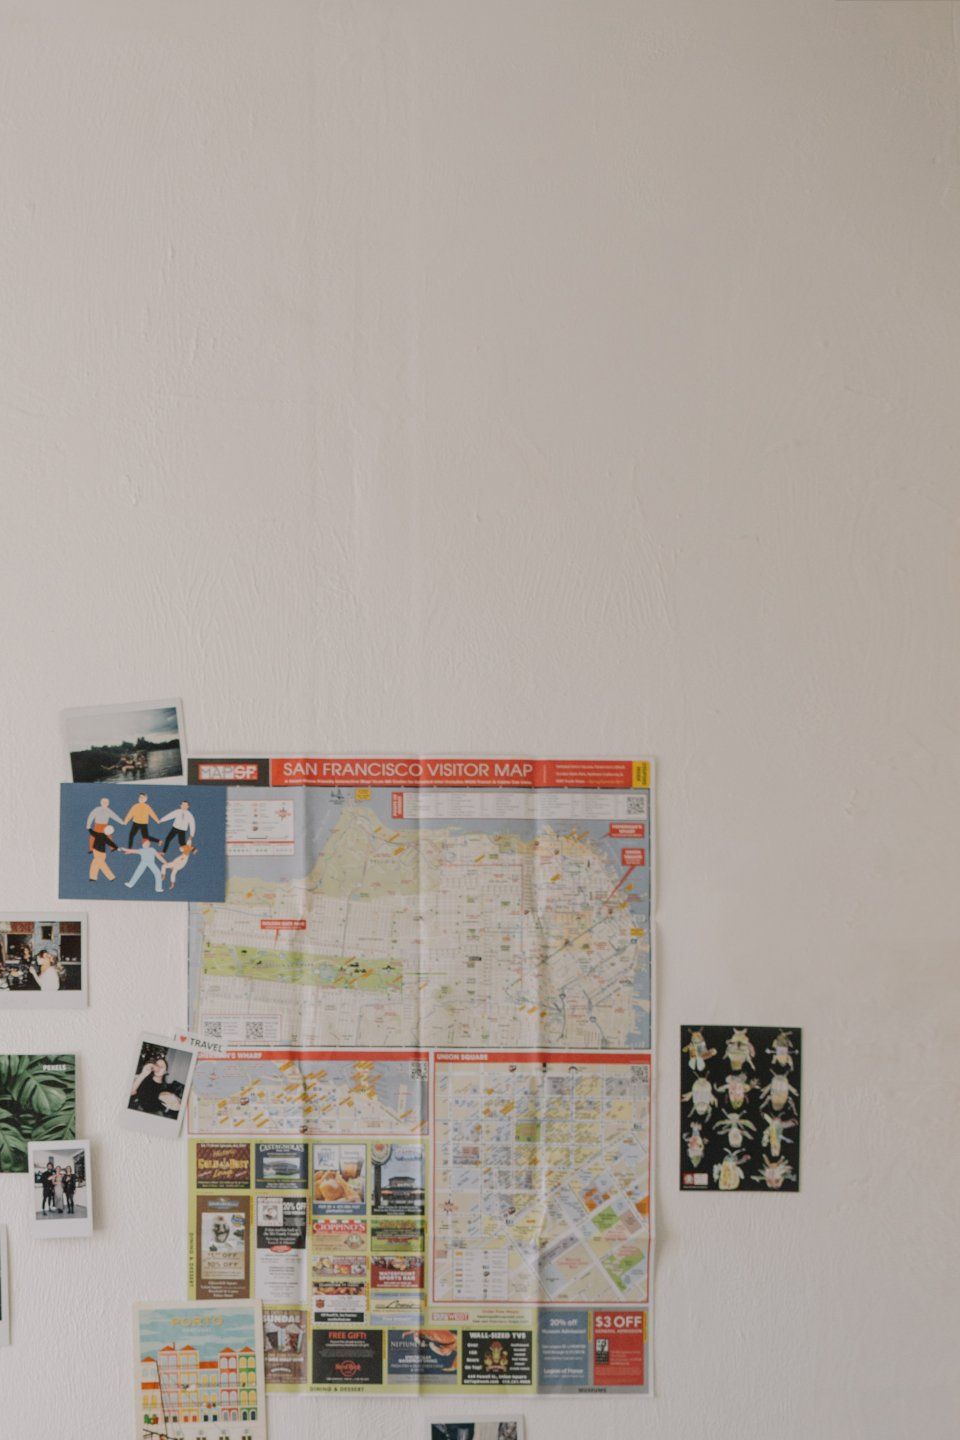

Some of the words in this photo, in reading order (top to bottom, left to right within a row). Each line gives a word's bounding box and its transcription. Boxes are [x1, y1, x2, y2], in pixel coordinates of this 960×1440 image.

[283, 762, 318, 777] SAN
[322, 762, 424, 777] FRANCISCO
[427, 763, 489, 777] VISITOR
[493, 763, 534, 777] MAP
[190, 1037, 223, 1053] TRAVEL
[437, 1053, 459, 1061] UNION
[461, 1053, 489, 1061] SQUARE
[595, 1316, 611, 1328] $3
[614, 1316, 642, 1328] OFF
[328, 1331, 346, 1339] FREE
[347, 1331, 367, 1339] GIFT!
